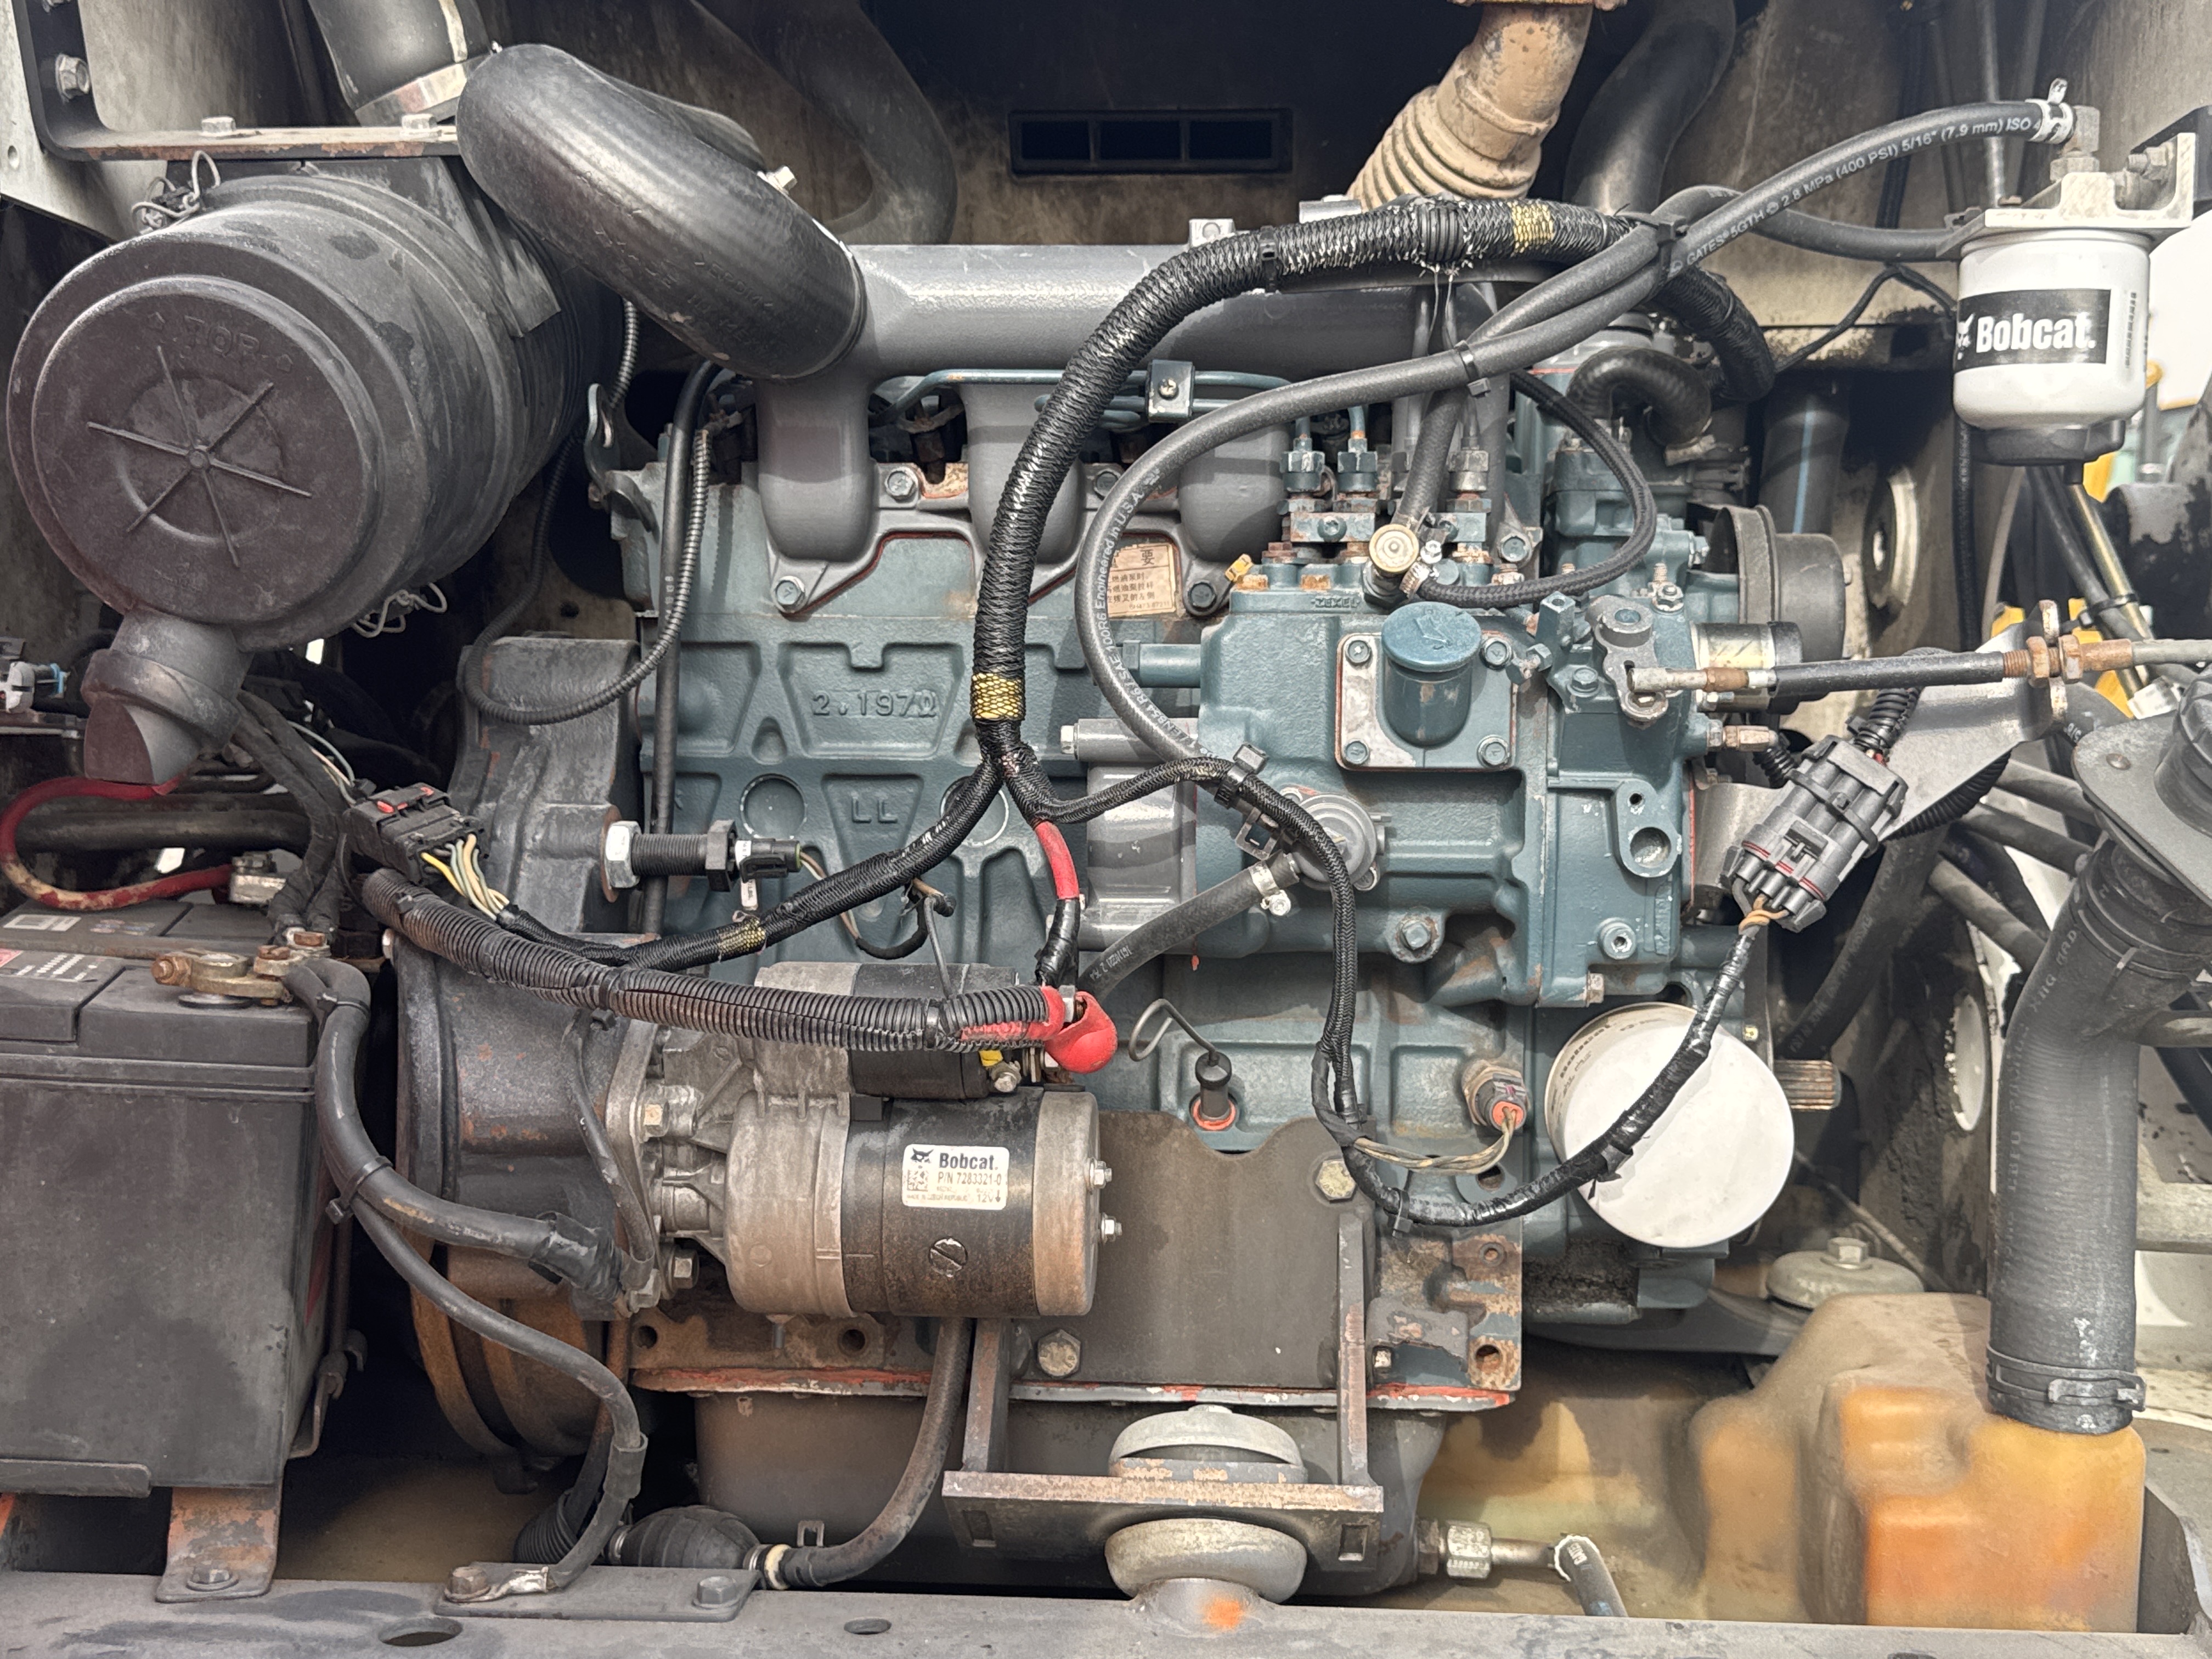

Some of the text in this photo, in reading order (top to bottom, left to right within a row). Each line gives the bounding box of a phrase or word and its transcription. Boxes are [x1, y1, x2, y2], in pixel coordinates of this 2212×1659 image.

[1781, 189, 1801, 207] 2.8
[1804, 173, 1833, 194] MPa
[1836, 157, 1865, 179] (400
[1867, 143, 1898, 165] PSI)
[1941, 125, 1969, 142] (7.9
[1972, 119, 2003, 134] mm)
[2005, 117, 2030, 131] ISO
[1094, 538, 1115, 610] Engineered
[1097, 613, 1115, 651] 100R6
[938, 1171, 1002, 1186] P/N 7283321-0
[977, 1194, 994, 1203] 12V
